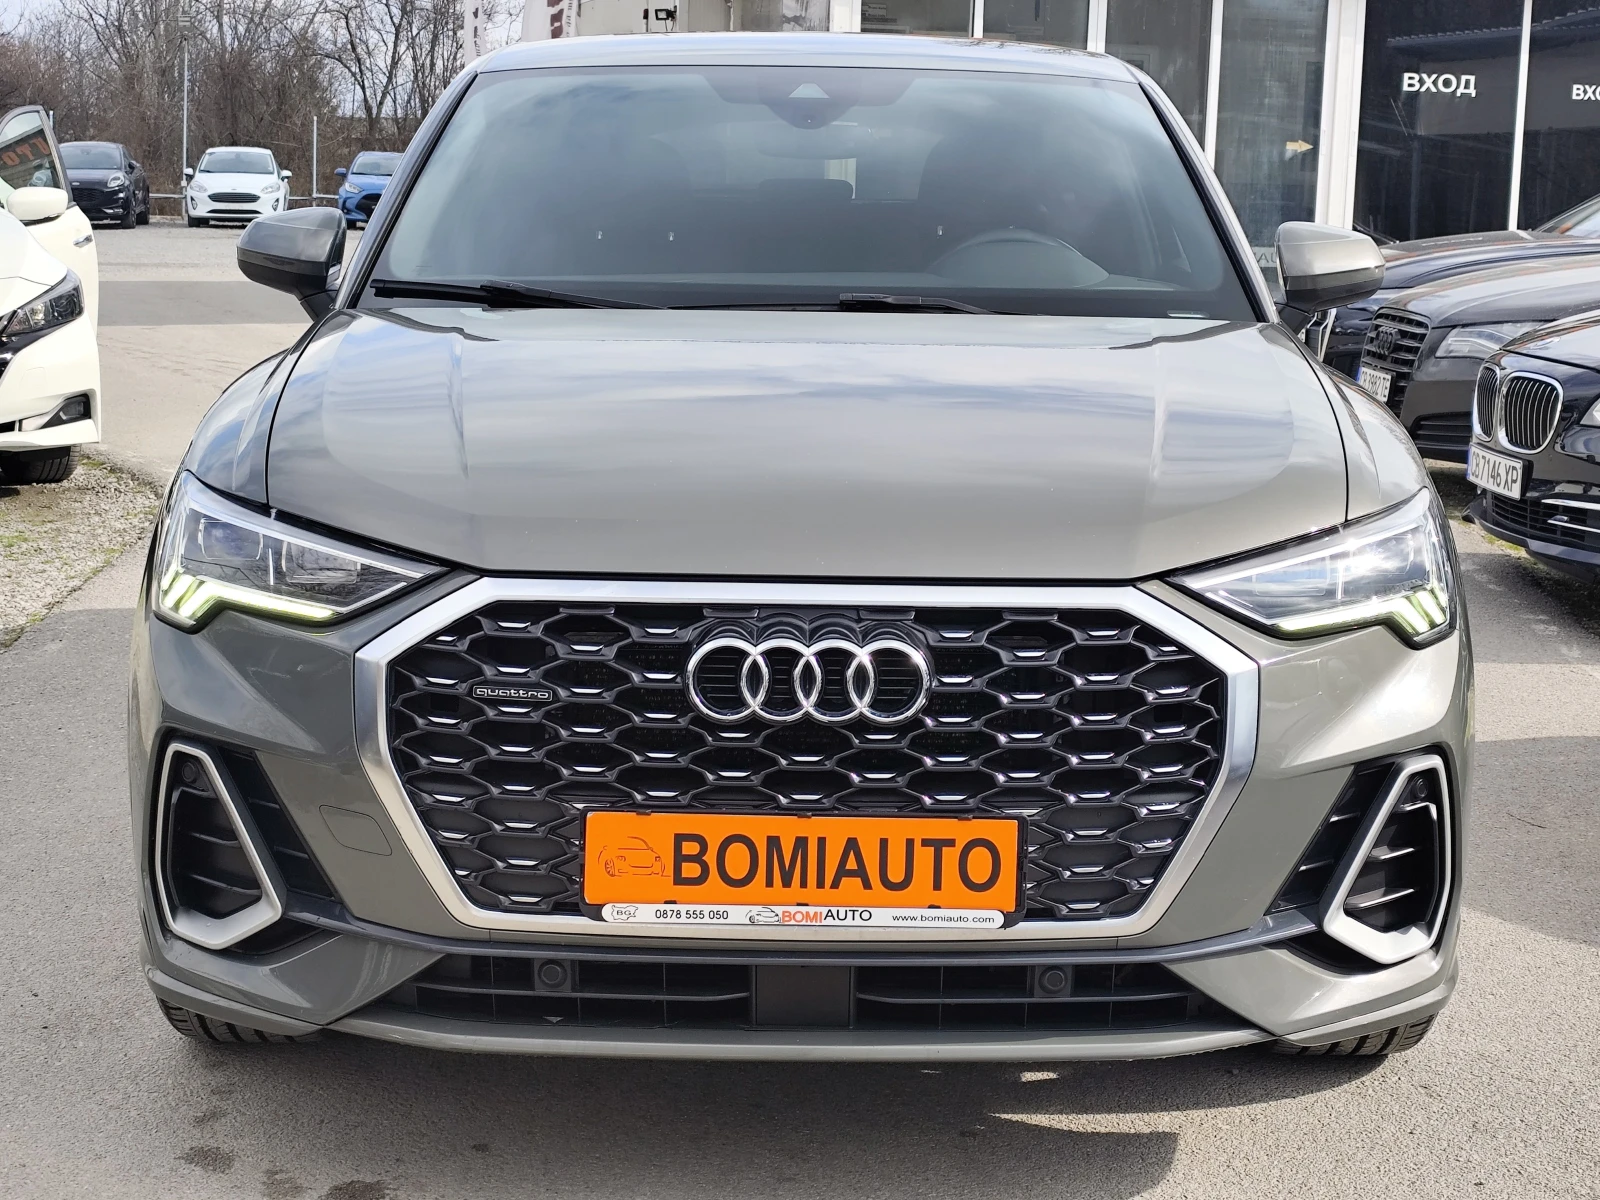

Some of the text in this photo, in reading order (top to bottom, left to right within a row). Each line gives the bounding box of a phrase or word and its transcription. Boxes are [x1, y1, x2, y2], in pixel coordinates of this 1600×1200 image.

[1402, 72, 1477, 98] ВХОД
[1481, 455, 1502, 488] 7146
[1503, 463, 1519, 492] XP
[476, 688, 549, 699] quattro
[672, 832, 1001, 893] BOMIAUTO
[655, 909, 729, 920] 0878 555 050
[892, 914, 995, 924] www.bomiauto.com
